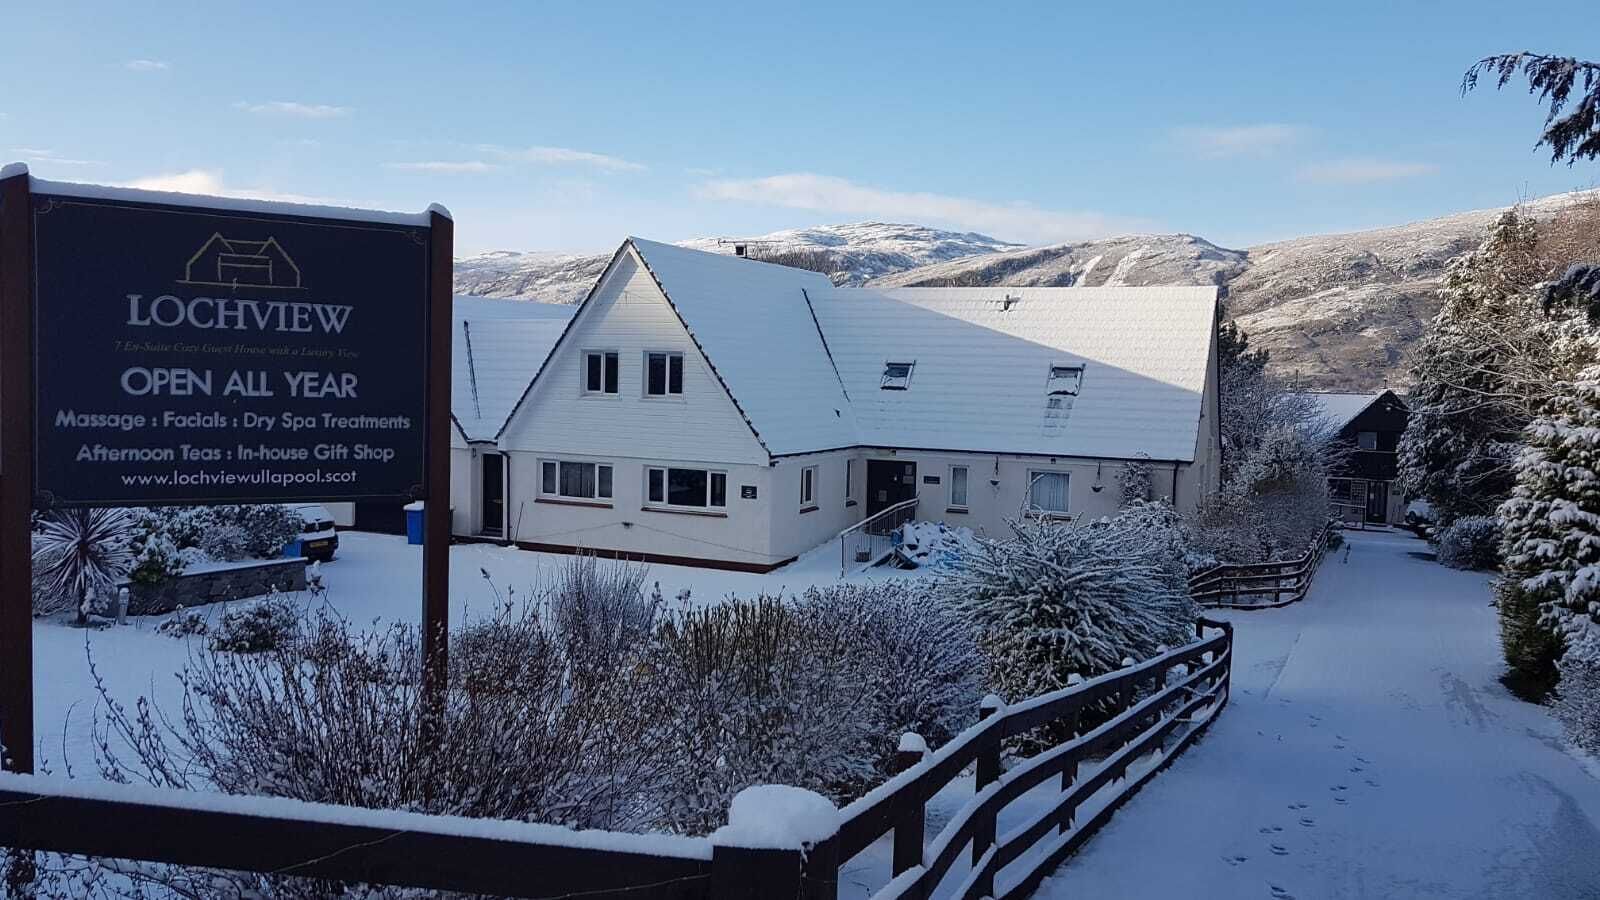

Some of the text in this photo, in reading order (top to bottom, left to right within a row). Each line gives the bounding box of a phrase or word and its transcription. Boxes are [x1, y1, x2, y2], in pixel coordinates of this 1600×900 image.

[126, 294, 354, 333] LOCHVIEW
[120, 367, 358, 399] OPEN ALL YEAR
[55, 410, 146, 430] Massage
[163, 411, 227, 428] Facials
[244, 413, 275, 431] Dry
[282, 413, 316, 431] Spa
[322, 413, 411, 430] Treatments
[76, 444, 174, 461] Afternoon
[180, 445, 221, 461] Teas
[238, 446, 307, 461] In-house
[314, 444, 348, 461] Gift
[354, 445, 394, 463] Shop
[121, 469, 357, 487] www.lochviewullapool.scot
